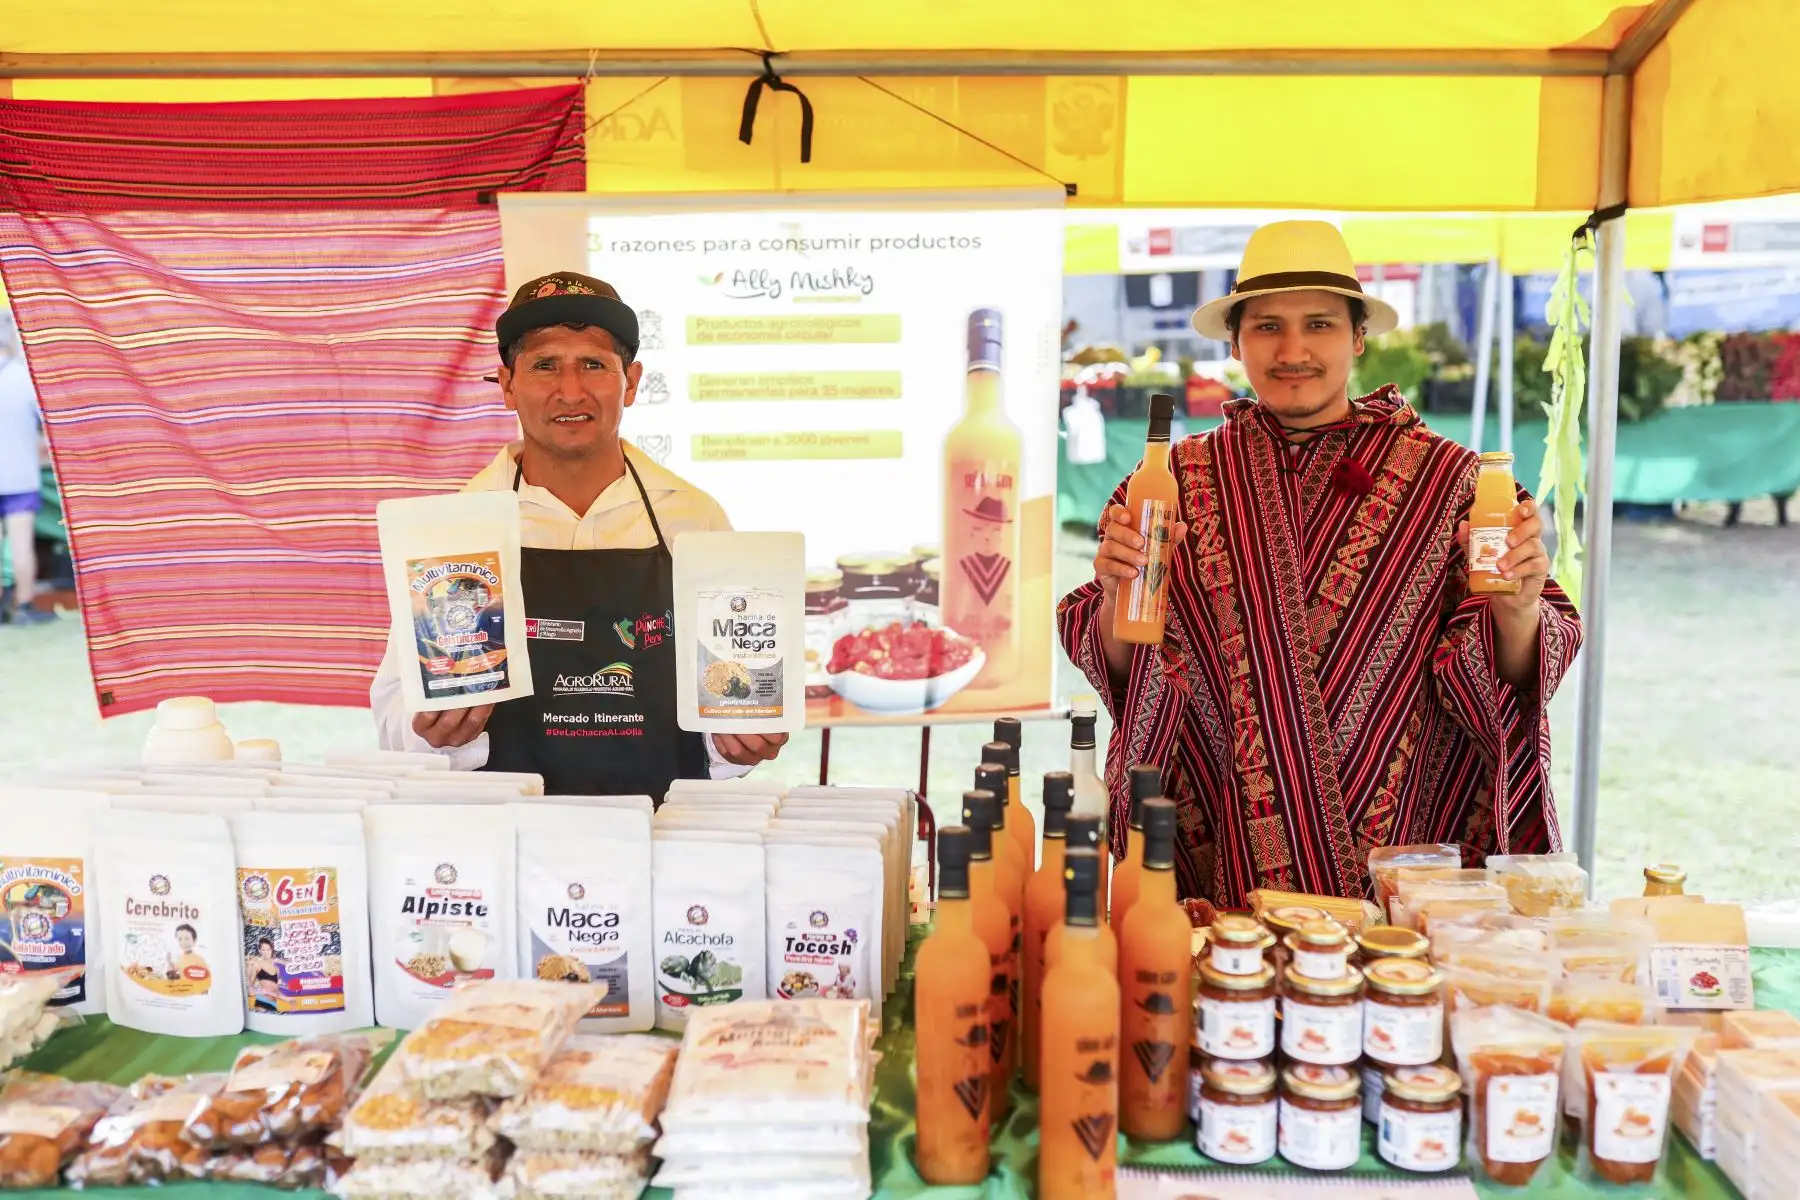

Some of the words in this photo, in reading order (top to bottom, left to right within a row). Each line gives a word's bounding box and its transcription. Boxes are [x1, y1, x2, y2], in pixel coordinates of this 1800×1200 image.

[610, 239, 697, 253] razones
[703, 237, 752, 255] para
[758, 233, 862, 252] consumir
[870, 232, 983, 253] productos
[731, 268, 782, 300] Ally
[526, 624, 538, 633] ERÚ
[712, 618, 777, 637] Maca
[731, 637, 776, 652] Negra
[543, 712, 590, 723] Mercado
[594, 712, 645, 723] Itinerante
[545, 728, 643, 737] #DeLaChacraALaOlla
[276, 878, 294, 905] 6
[296, 887, 314, 899] EN
[316, 875, 326, 902] 1
[125, 897, 200, 920] Cerebrito
[401, 895, 488, 921] Alpiste
[547, 907, 620, 928] Maca
[568, 929, 619, 946] Negra
[663, 930, 734, 945] Alcachofa
[785, 937, 852, 955] Tocosh
